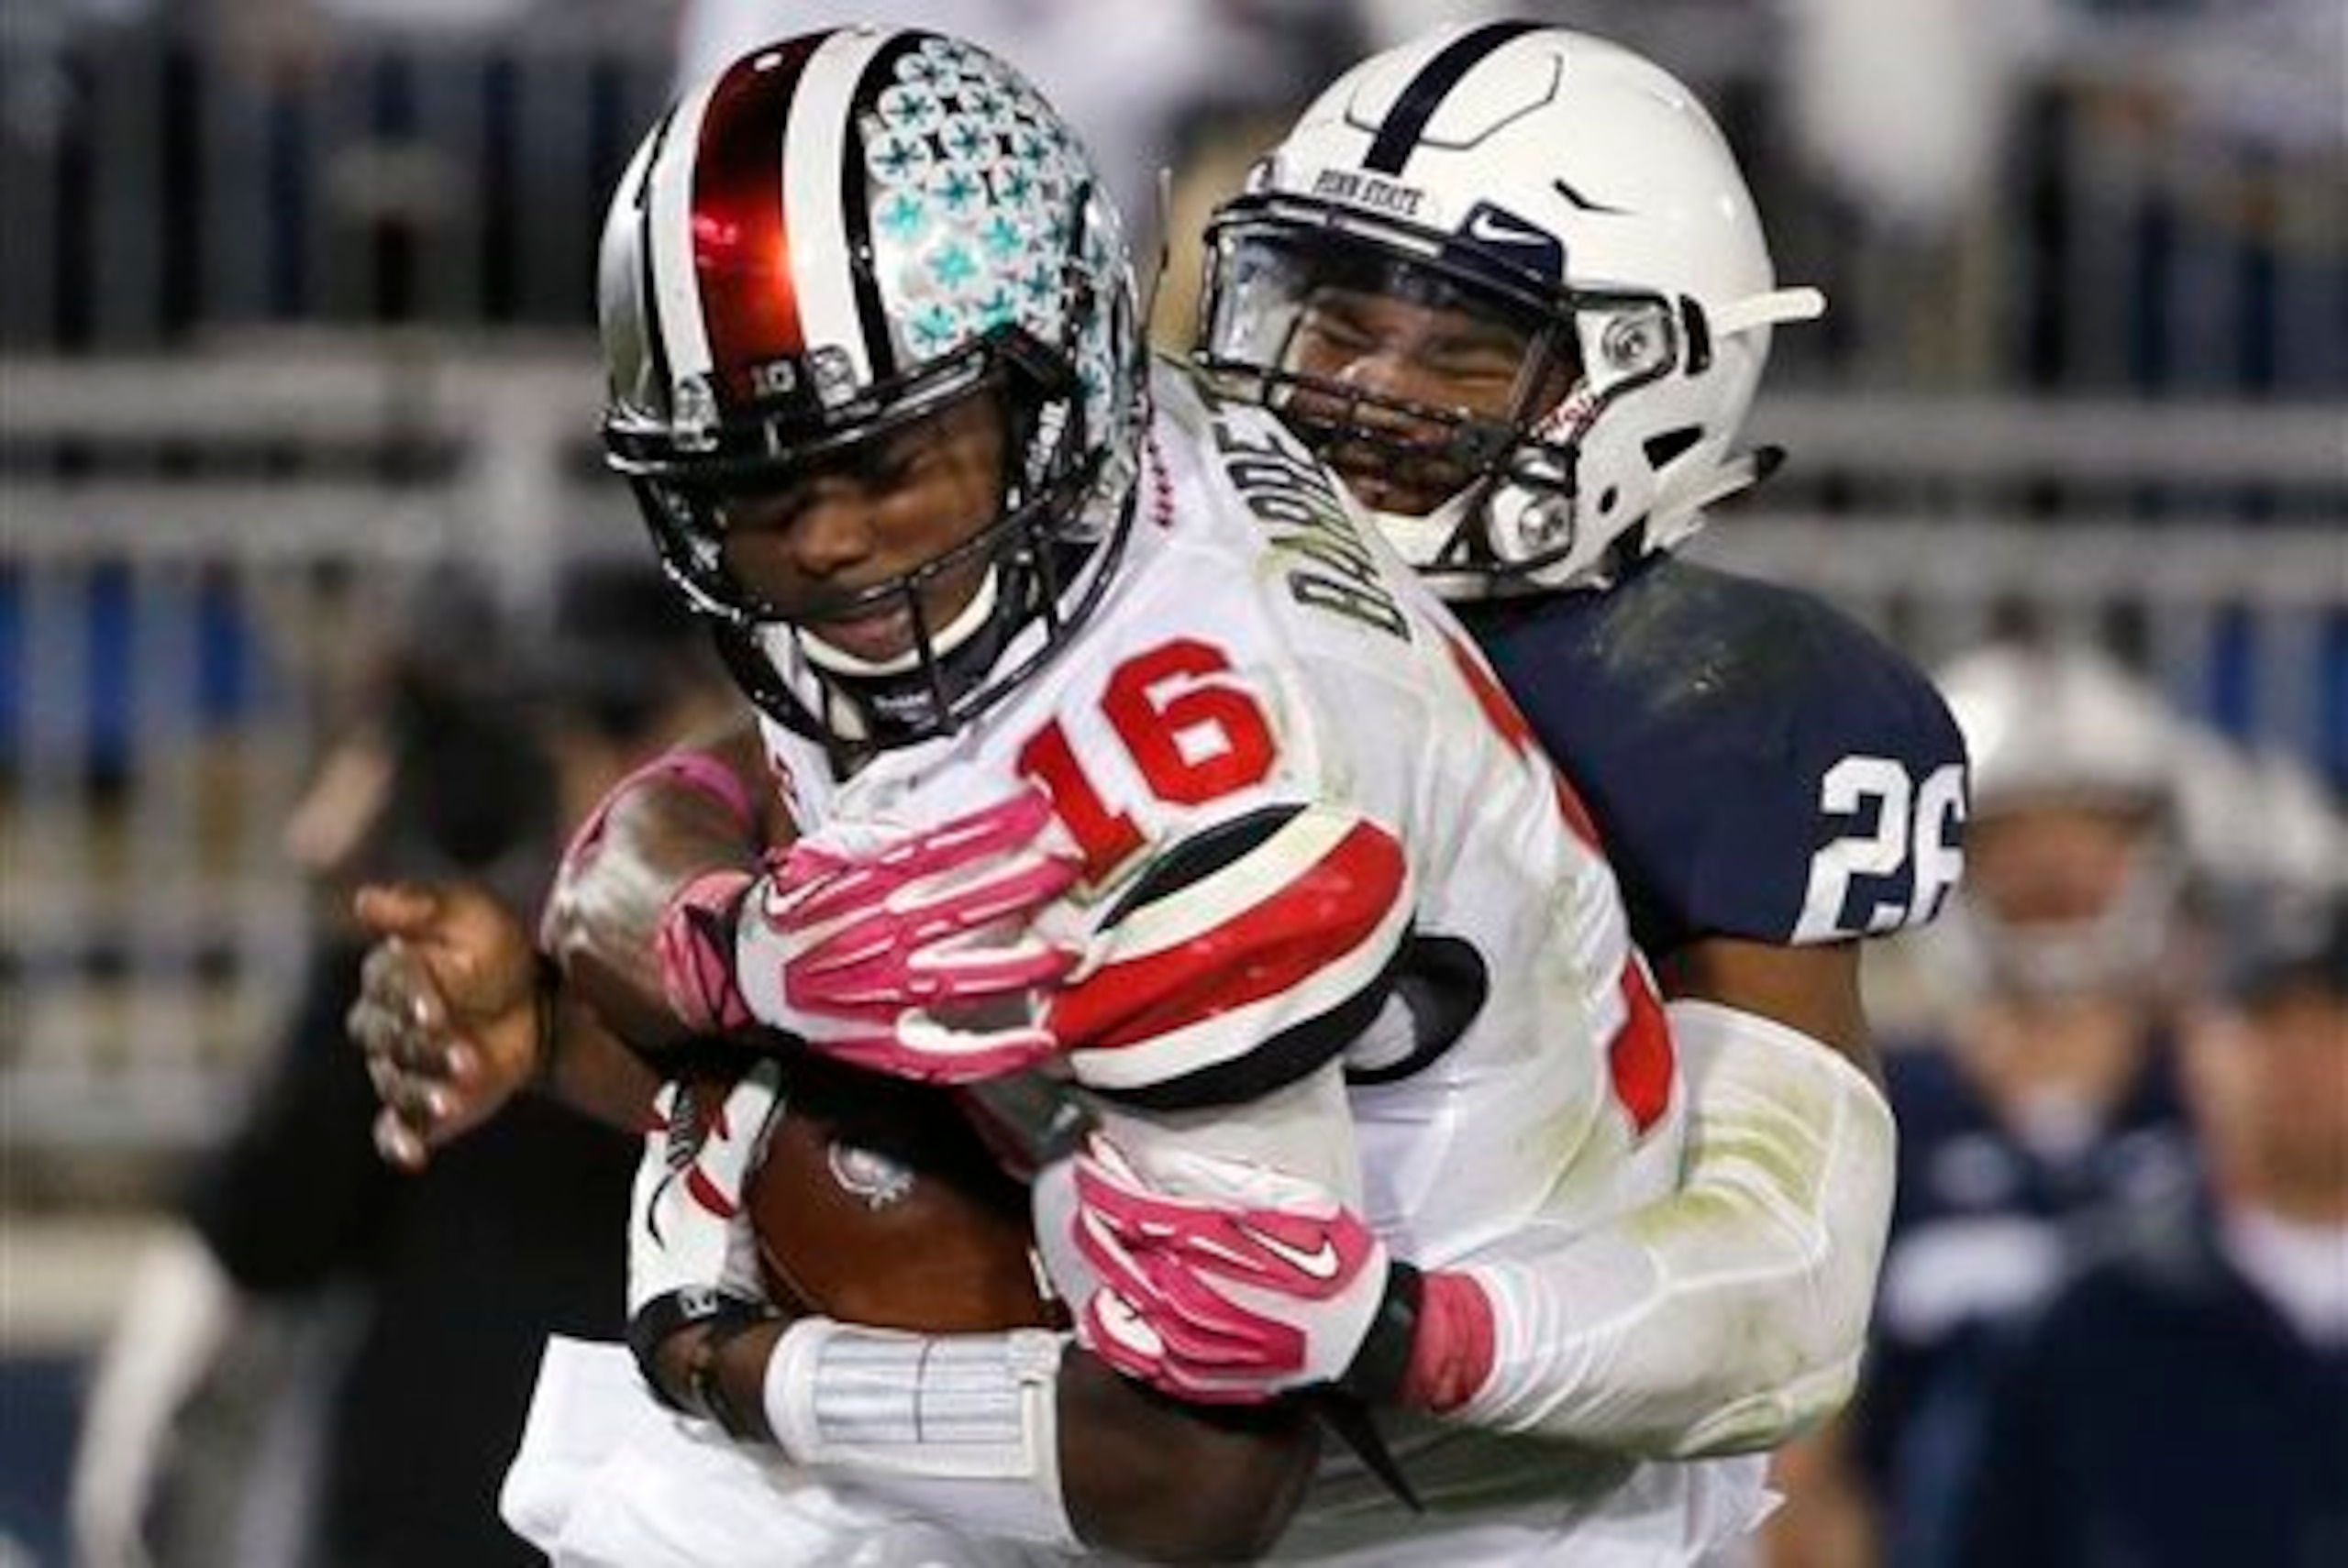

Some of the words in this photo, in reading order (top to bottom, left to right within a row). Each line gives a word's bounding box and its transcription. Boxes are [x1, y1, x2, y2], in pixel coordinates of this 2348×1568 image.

[1361, 179, 1424, 215] STATE
[1015, 636, 1279, 888] 16
[1790, 754, 1967, 945] 26
